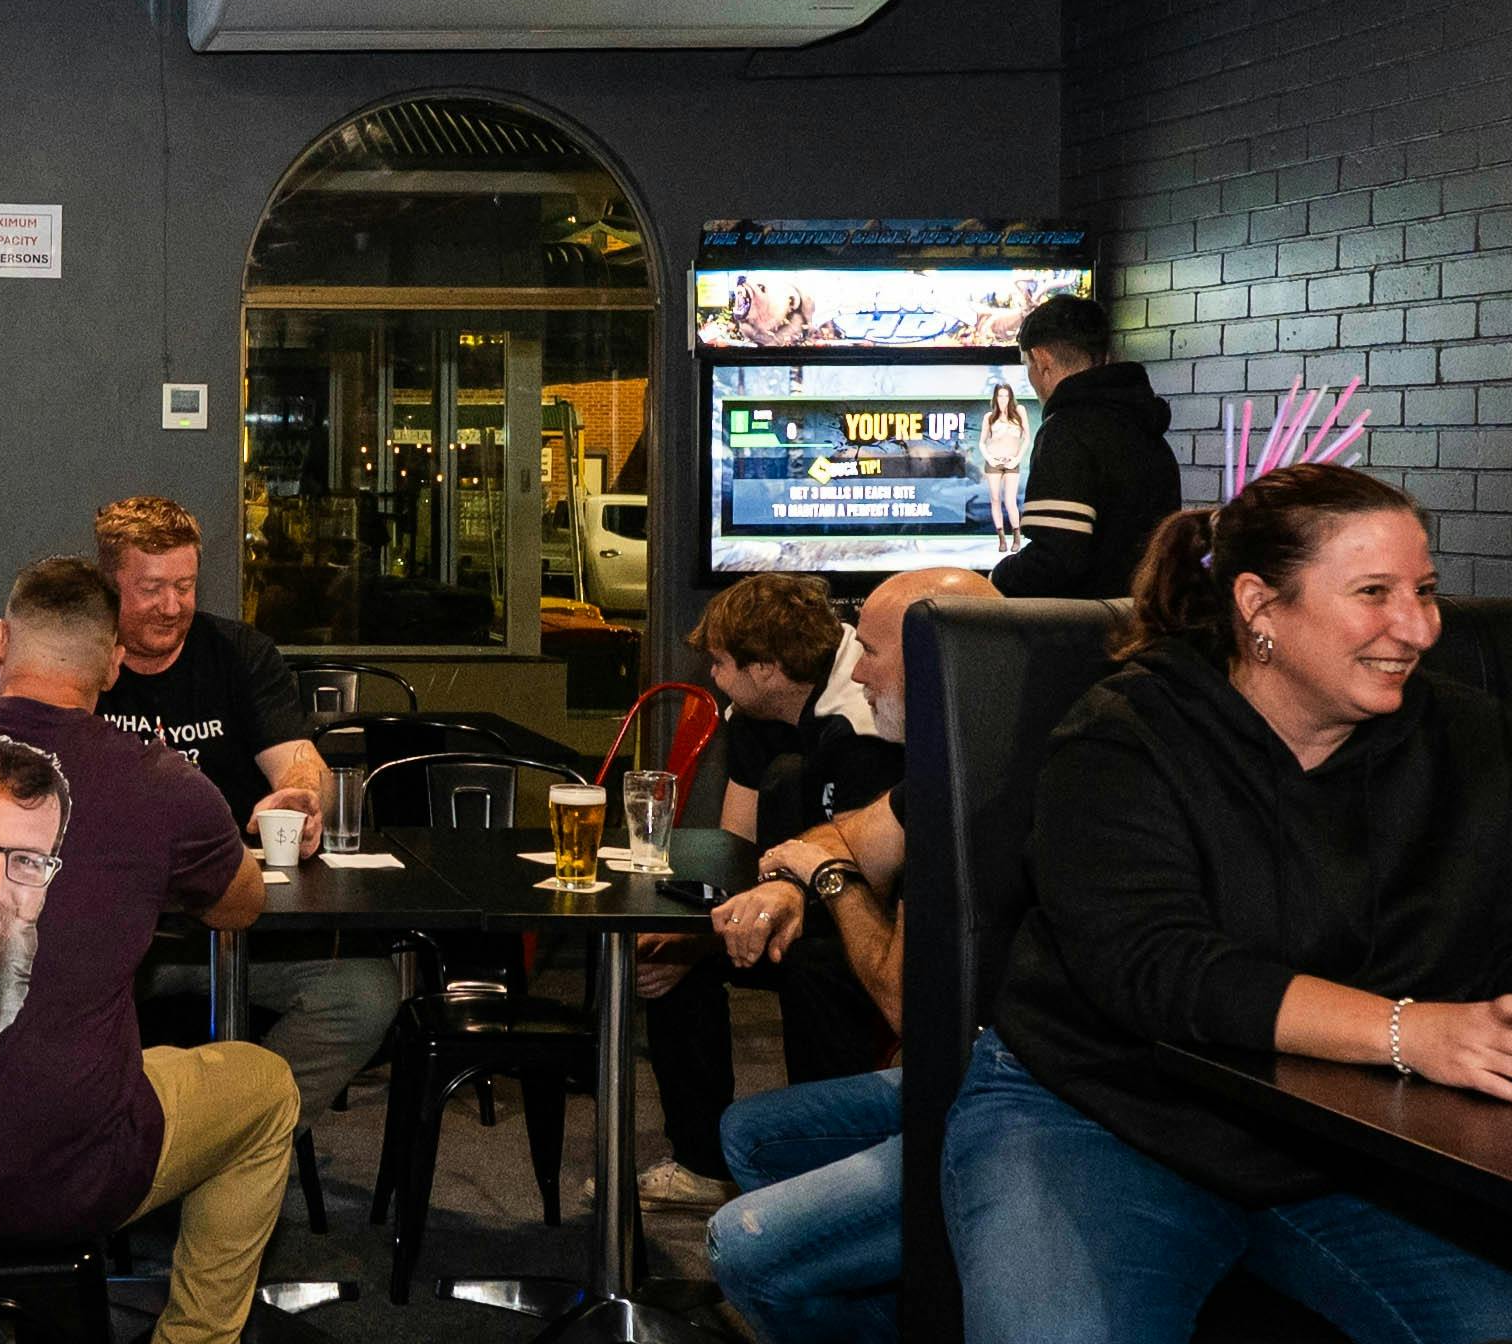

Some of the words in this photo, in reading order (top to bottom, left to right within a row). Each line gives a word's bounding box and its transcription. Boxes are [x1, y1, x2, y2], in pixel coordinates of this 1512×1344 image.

[845, 413, 923, 441] YOU'RE
[927, 412, 966, 441] UP!
[859, 459, 881, 475] TIP!
[772, 504, 787, 517] TO
[836, 504, 845, 517] A
[168, 719, 224, 744] YOUR
